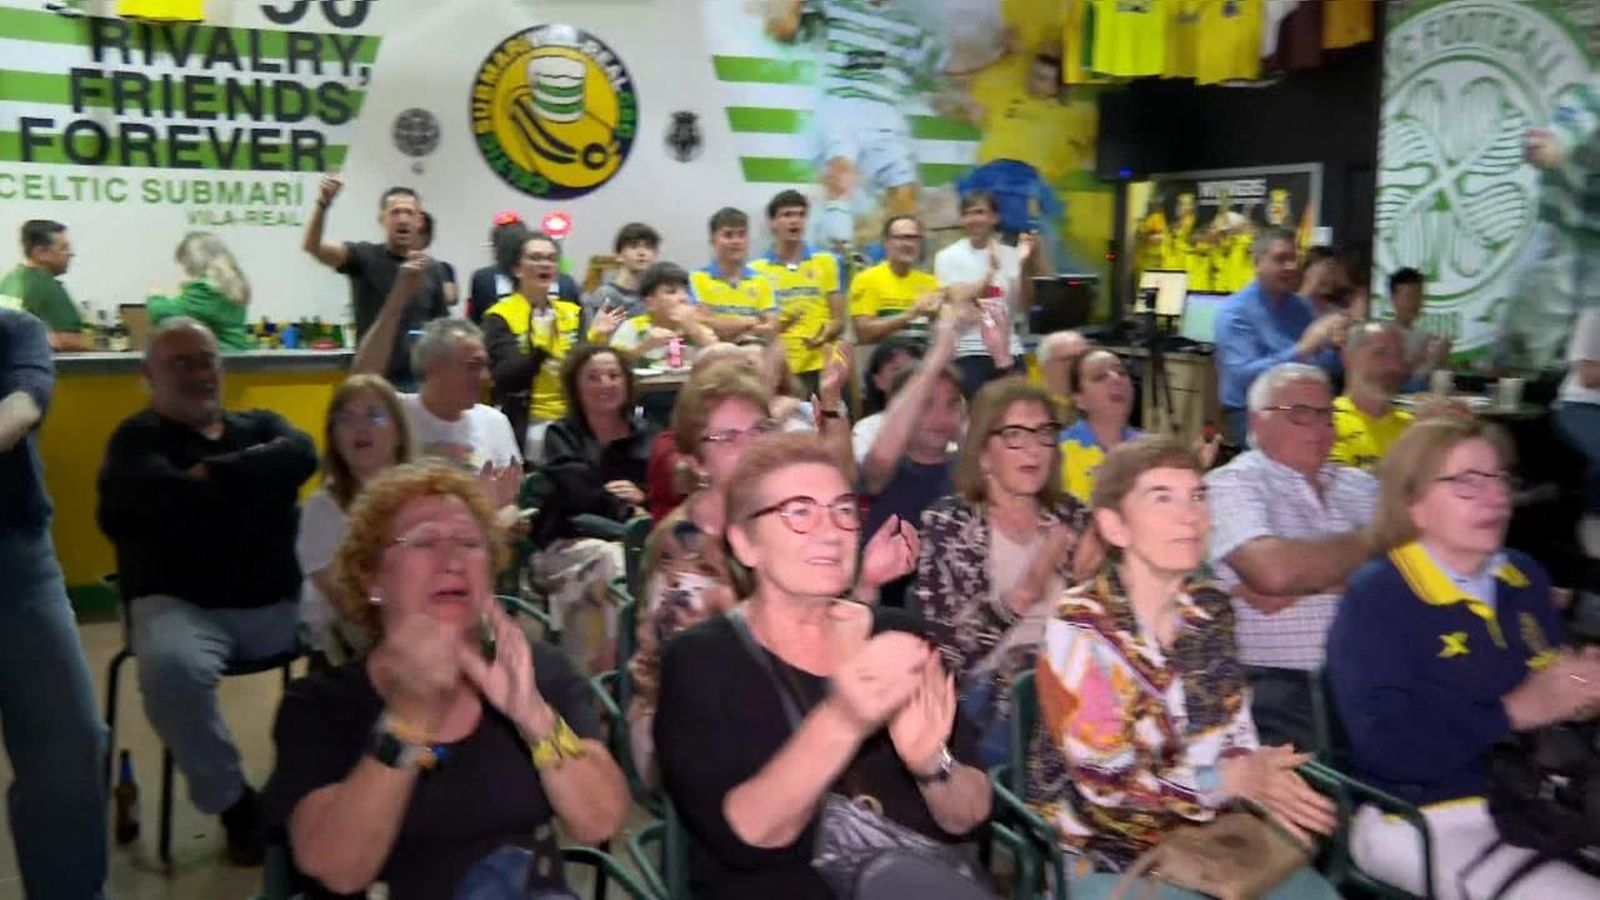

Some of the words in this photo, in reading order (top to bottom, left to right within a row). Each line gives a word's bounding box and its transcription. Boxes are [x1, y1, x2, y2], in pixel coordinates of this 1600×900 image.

[88, 16, 372, 86] RIVALRY,
[69, 67, 354, 126] FRIENDS
[19, 117, 327, 172] FOREVER
[0, 173, 127, 202] CELTIC
[142, 178, 304, 206] SUBMARI
[186, 210, 304, 227] VILA-REAL
